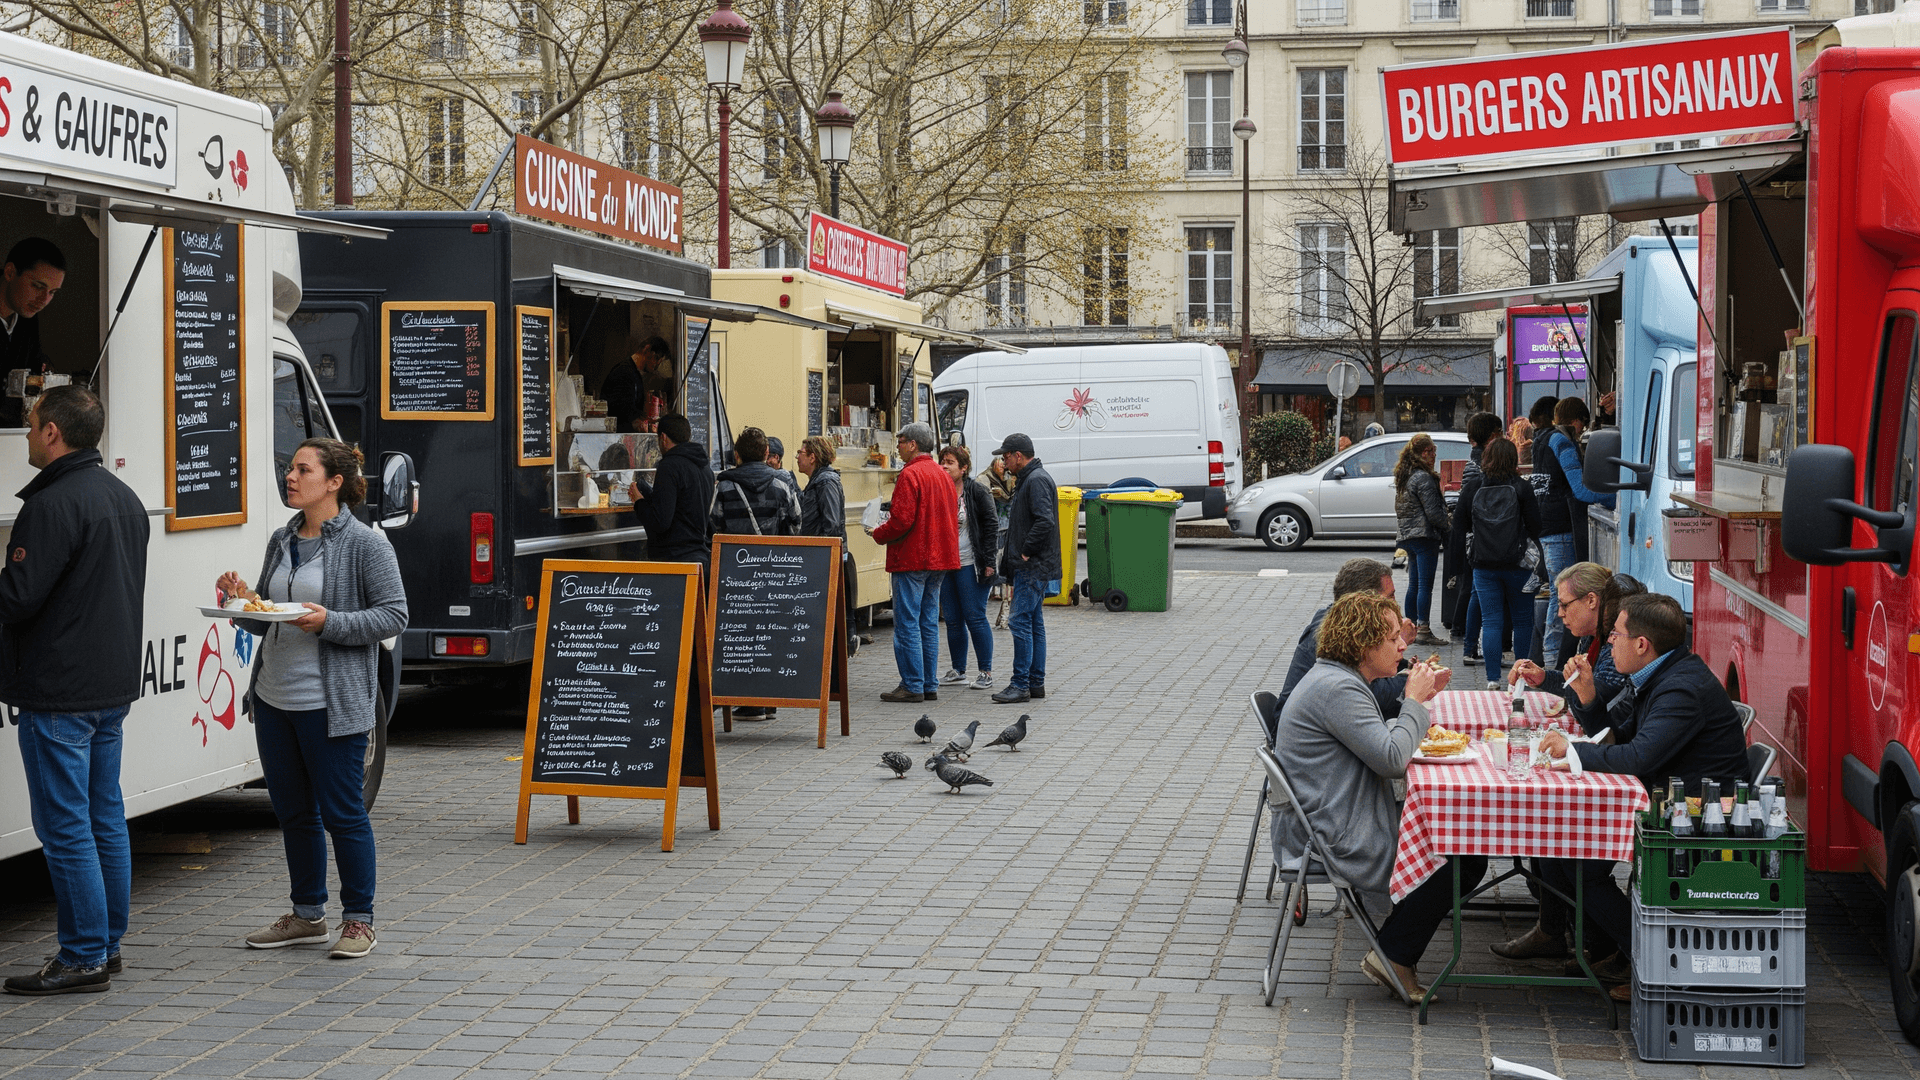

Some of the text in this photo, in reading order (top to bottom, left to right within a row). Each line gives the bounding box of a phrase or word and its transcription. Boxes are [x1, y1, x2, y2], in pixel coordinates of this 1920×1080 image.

[22, 85, 42, 144] &
[55, 91, 169, 170] GAUFRES
[1398, 52, 1783, 144] BURGERS ARTISANAUX
[525, 148, 679, 244] CUISINE du MONDE
